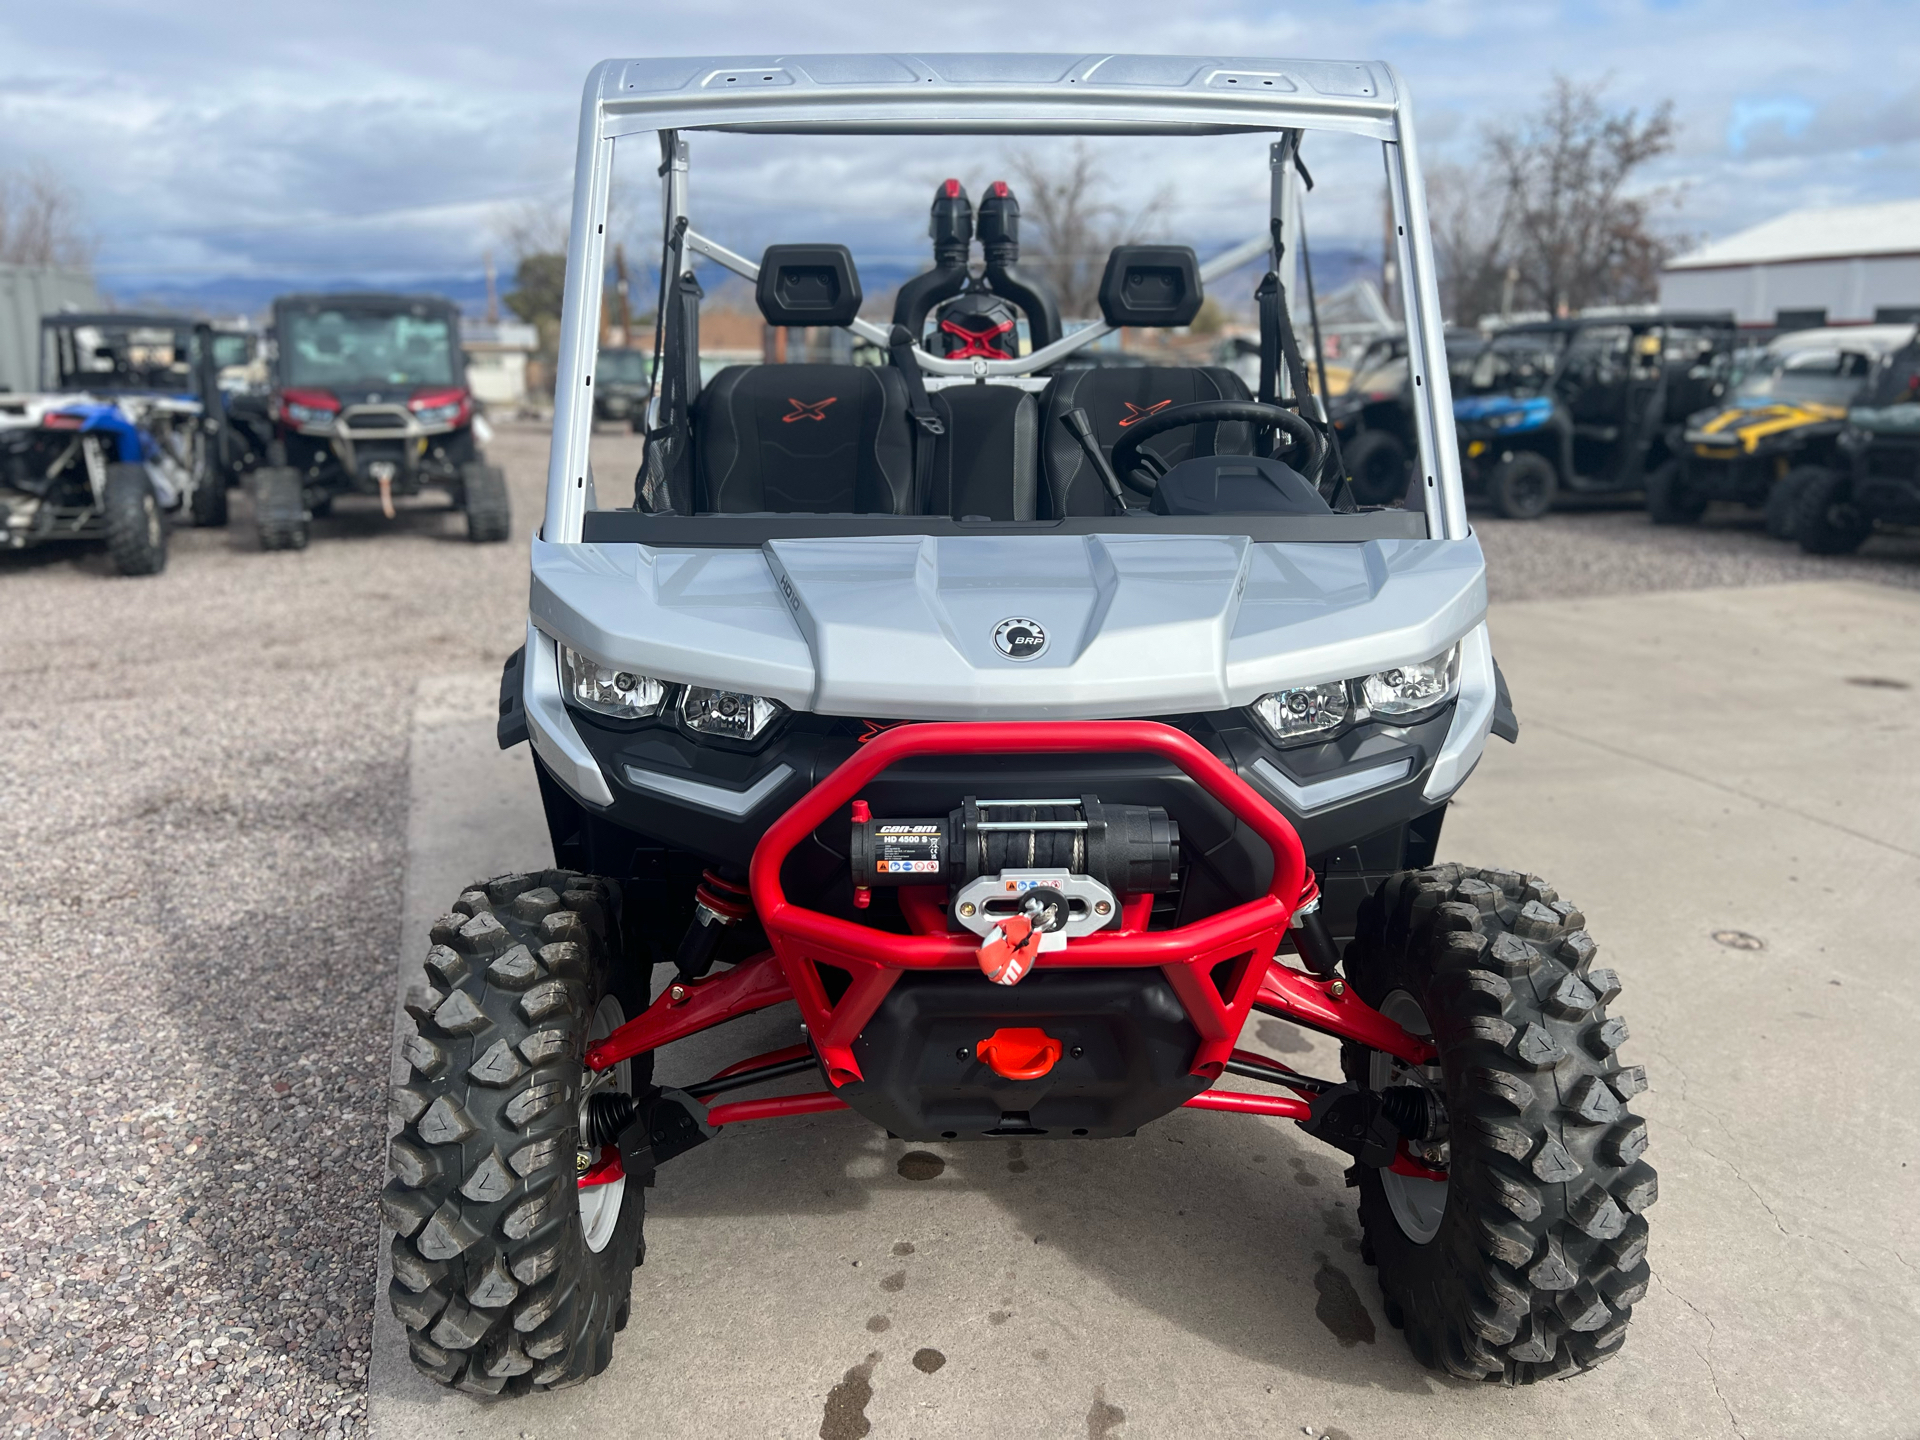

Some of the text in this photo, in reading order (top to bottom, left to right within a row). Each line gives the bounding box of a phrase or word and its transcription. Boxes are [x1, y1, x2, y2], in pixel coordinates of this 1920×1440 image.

[1014, 636, 1044, 645] BRP
[883, 835, 928, 843] HD 4500 S
